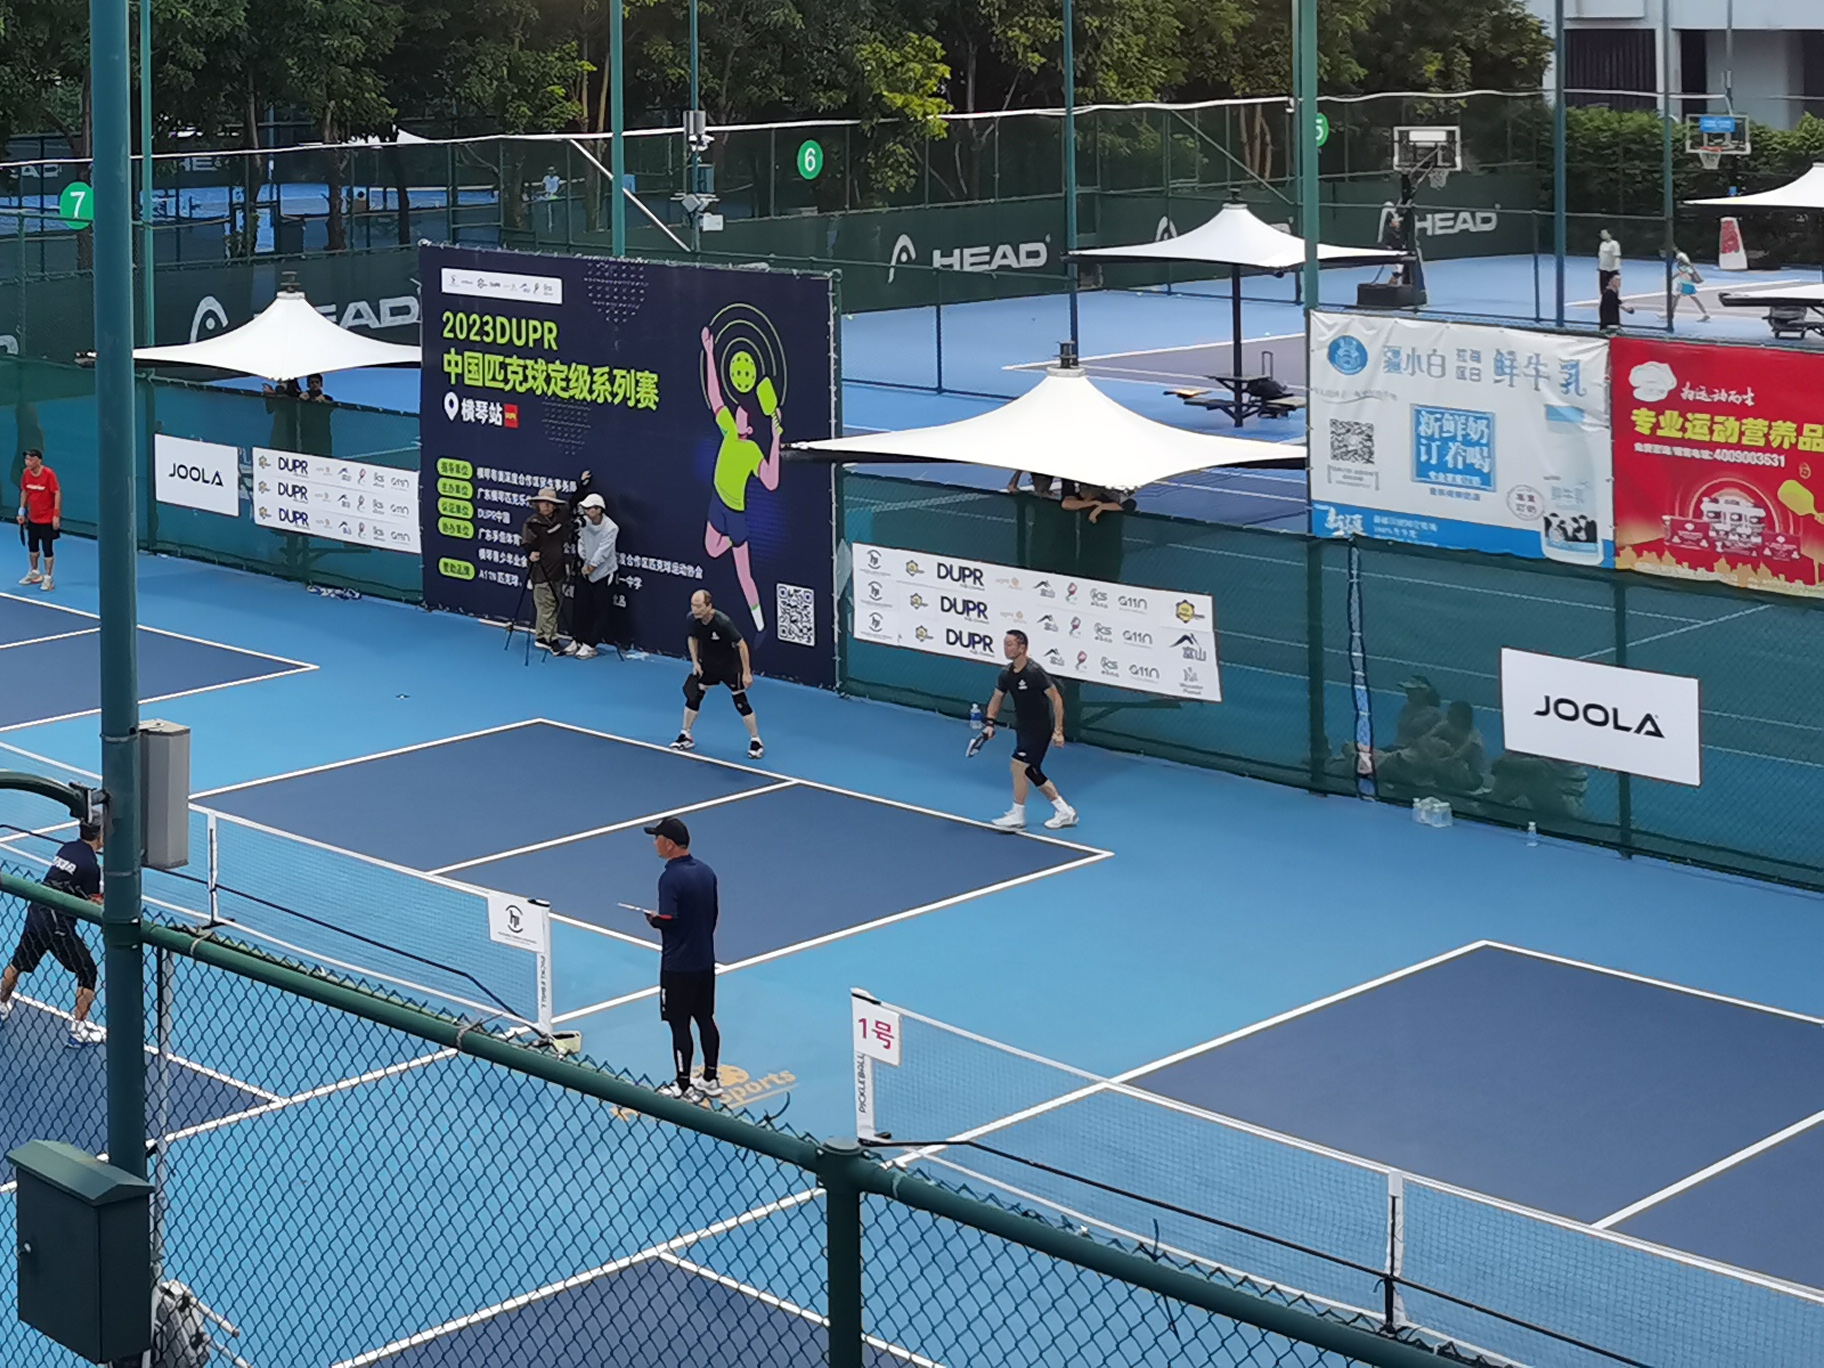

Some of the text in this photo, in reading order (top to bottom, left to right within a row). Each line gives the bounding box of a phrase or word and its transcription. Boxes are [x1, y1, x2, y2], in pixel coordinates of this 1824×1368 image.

[803, 148, 816, 171] 6
[70, 192, 86, 219] 7
[1415, 211, 1497, 237] HEAD
[932, 242, 1048, 272] HEAD
[442, 310, 558, 351] 2023DUPR
[443, 348, 660, 411] 中国匹克球定级系列赛
[461, 397, 503, 427] 横琴站
[1418, 410, 1490, 445] 新鲜奶
[169, 463, 224, 487] JOOLA
[278, 457, 308, 475] DUPR
[278, 482, 308, 500] DUPR
[279, 508, 309, 526] DUPR
[937, 562, 985, 587] DUPR
[940, 595, 989, 620] DUPR
[946, 628, 995, 654] DUPR
[1533, 695, 1665, 739] JOOLA
[858, 1018, 895, 1050] 1号
[857, 1053, 866, 1114] PICKLEBALL
